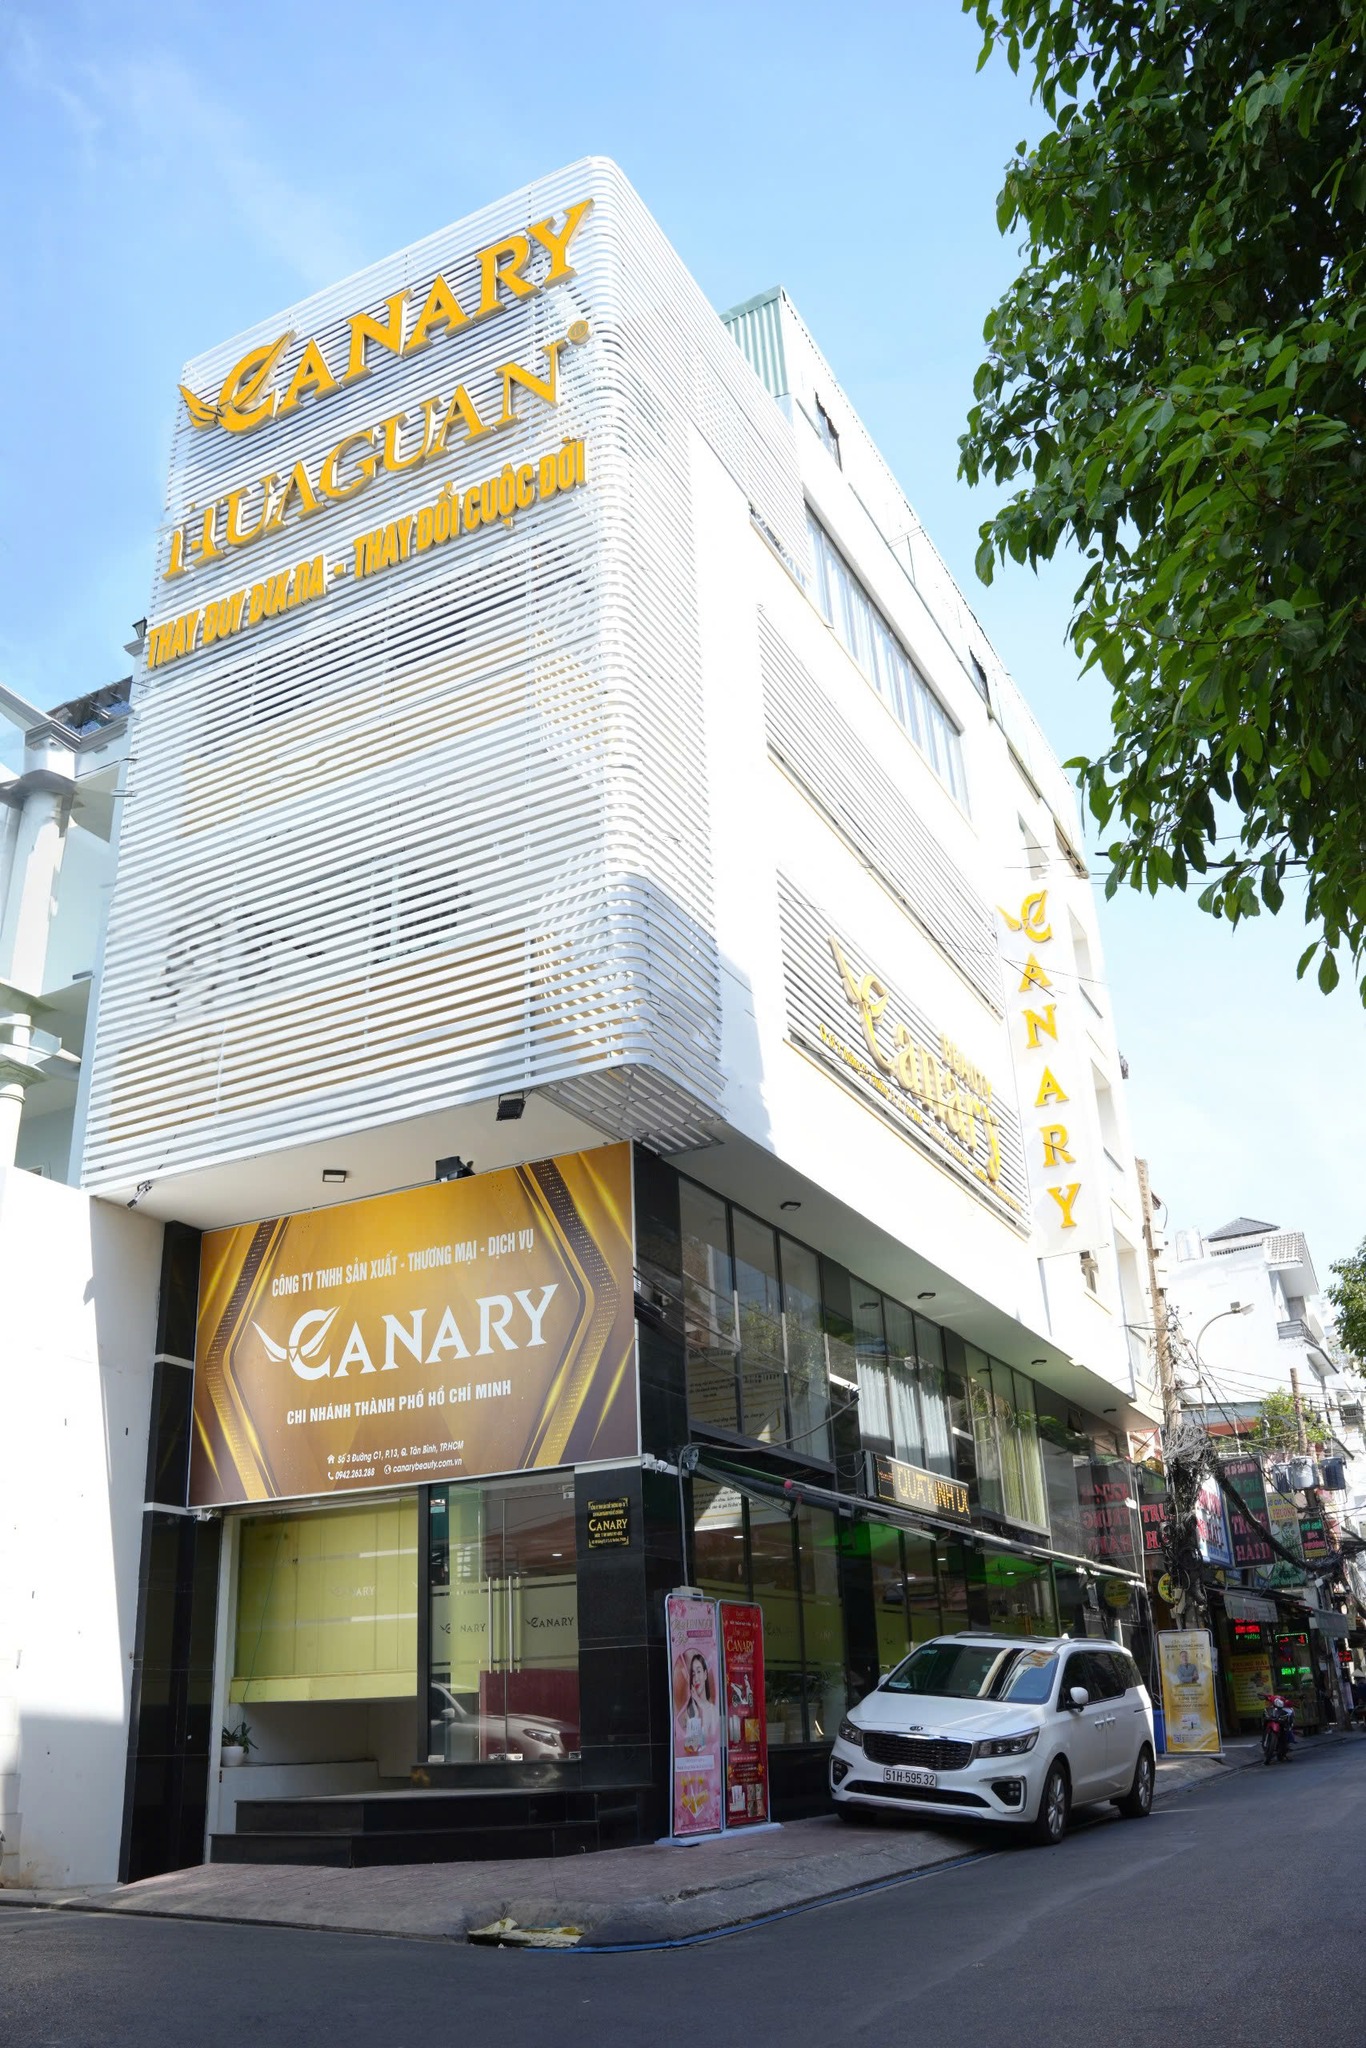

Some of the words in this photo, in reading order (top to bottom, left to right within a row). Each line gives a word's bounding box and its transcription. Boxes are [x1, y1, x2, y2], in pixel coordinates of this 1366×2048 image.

[178, 199, 594, 436] CANARY
[148, 608, 201, 670] THAY
[353, 513, 417, 581] THAY
[463, 462, 537, 531] CUỘC
[997, 889, 1083, 1229] CANARY
[272, 1274, 299, 1297] CÔNG
[301, 1272, 314, 1292] TY
[316, 1266, 343, 1290] TNHH
[345, 1257, 368, 1284] SẢN
[370, 1250, 398, 1280] XUẤT
[407, 1245, 452, 1272] THƯƠNG
[454, 1239, 478, 1266] MẠI
[488, 1231, 515, 1260] DỊCH
[518, 1228, 534, 1253] VỤ
[251, 1283, 560, 1381] CANARY
[286, 1409, 307, 1425] CHI
[309, 1402, 351, 1423] NHÁNH
[354, 1396, 395, 1417] THÀNH
[398, 1387, 425, 1412] PHỐ
[428, 1385, 446, 1407] HỒ
[449, 1383, 472, 1404] CHÍ
[475, 1379, 511, 1400] MINH
[589, 1519, 628, 1532] CANARY
[526, 1616, 574, 1628] CANARY
[885, 1769, 935, 1787] 51H-595.32
